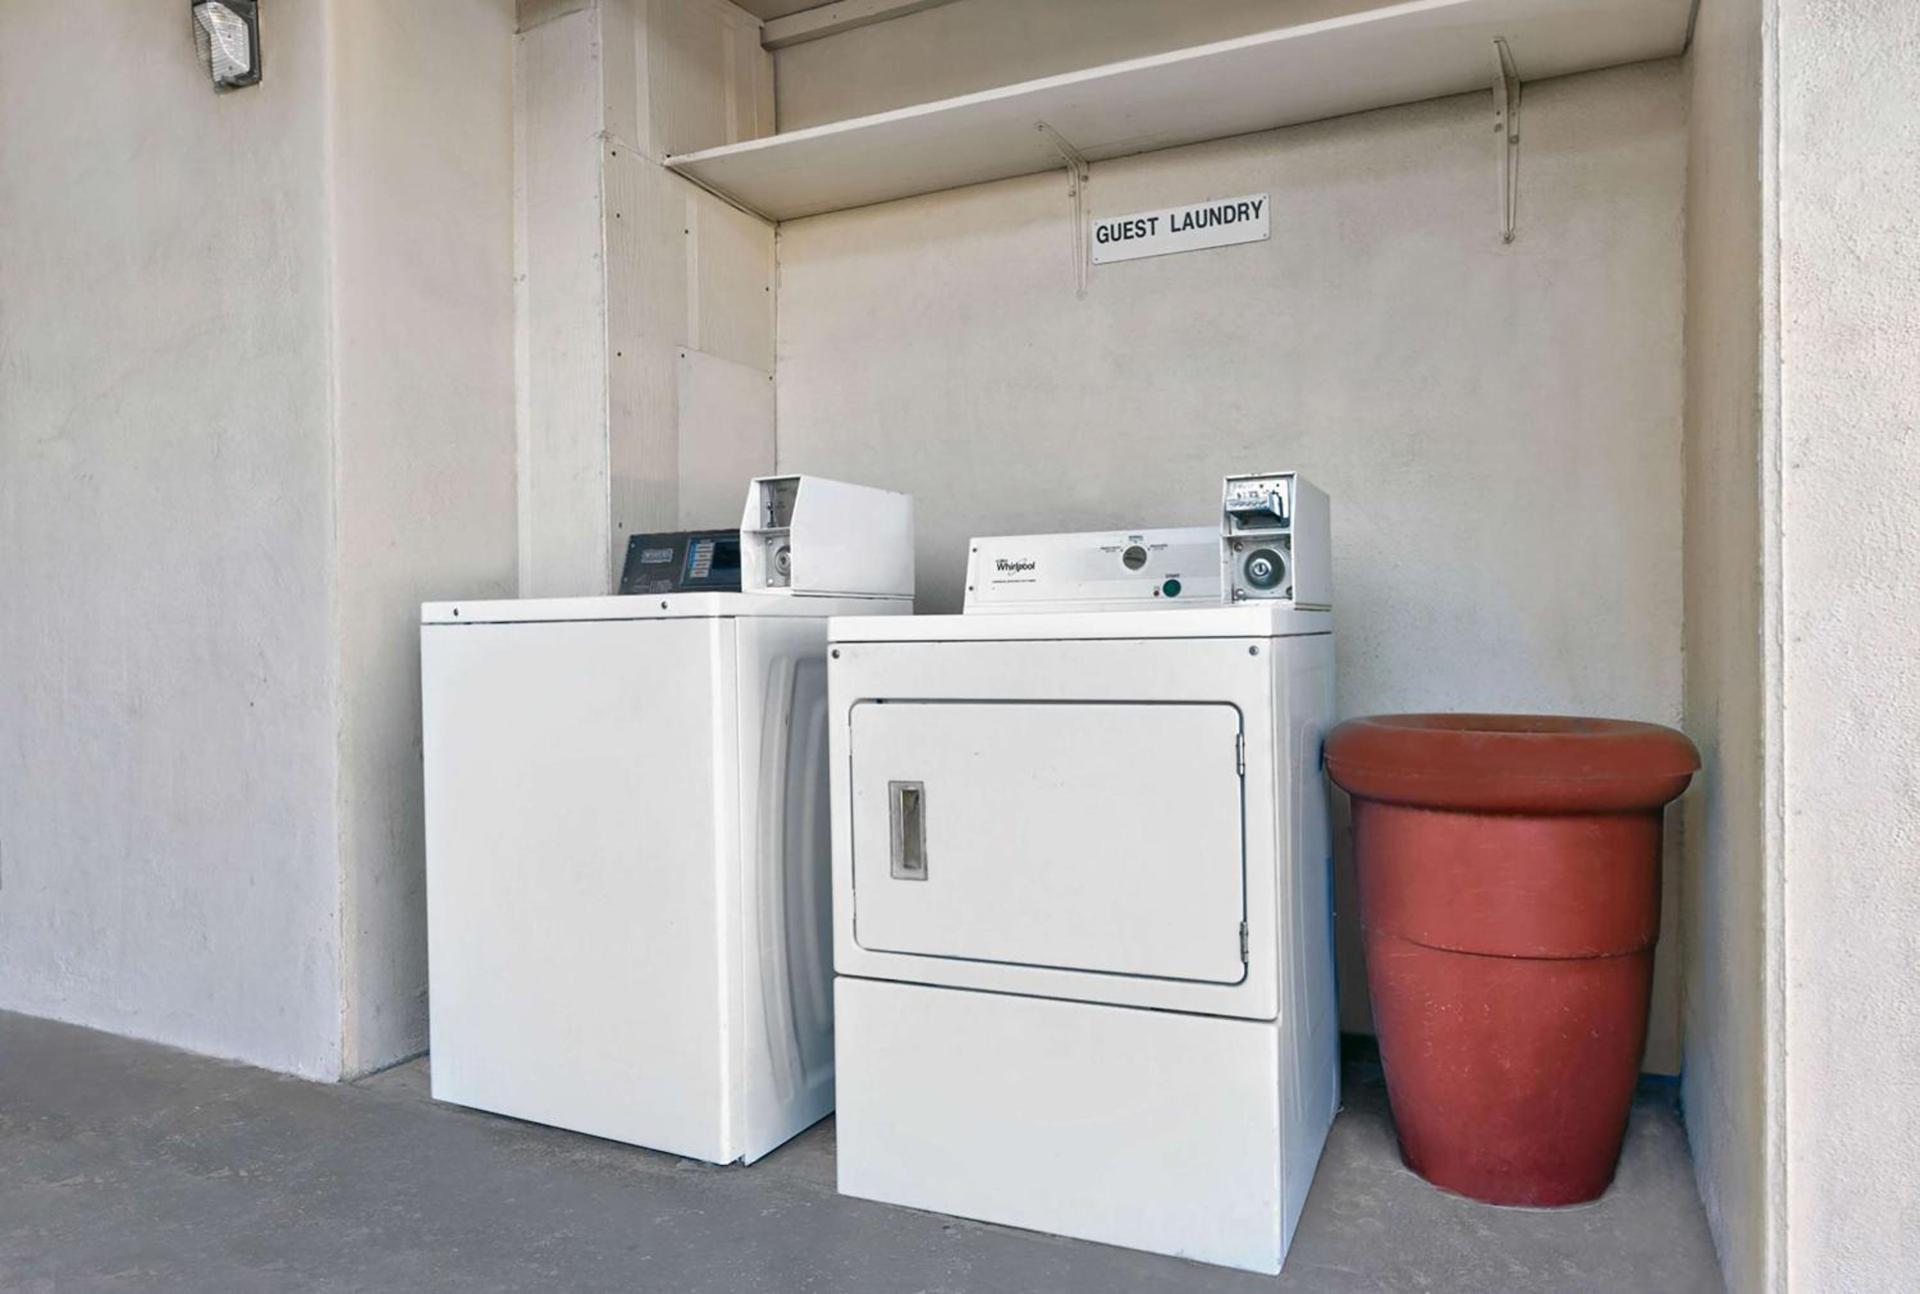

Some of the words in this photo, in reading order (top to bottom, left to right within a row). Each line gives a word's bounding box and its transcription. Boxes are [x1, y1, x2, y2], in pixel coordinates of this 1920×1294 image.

[1096, 217, 1159, 244] GUEST
[1170, 200, 1263, 233] LAUNDRY
[996, 561, 1036, 573] Whirlpool
